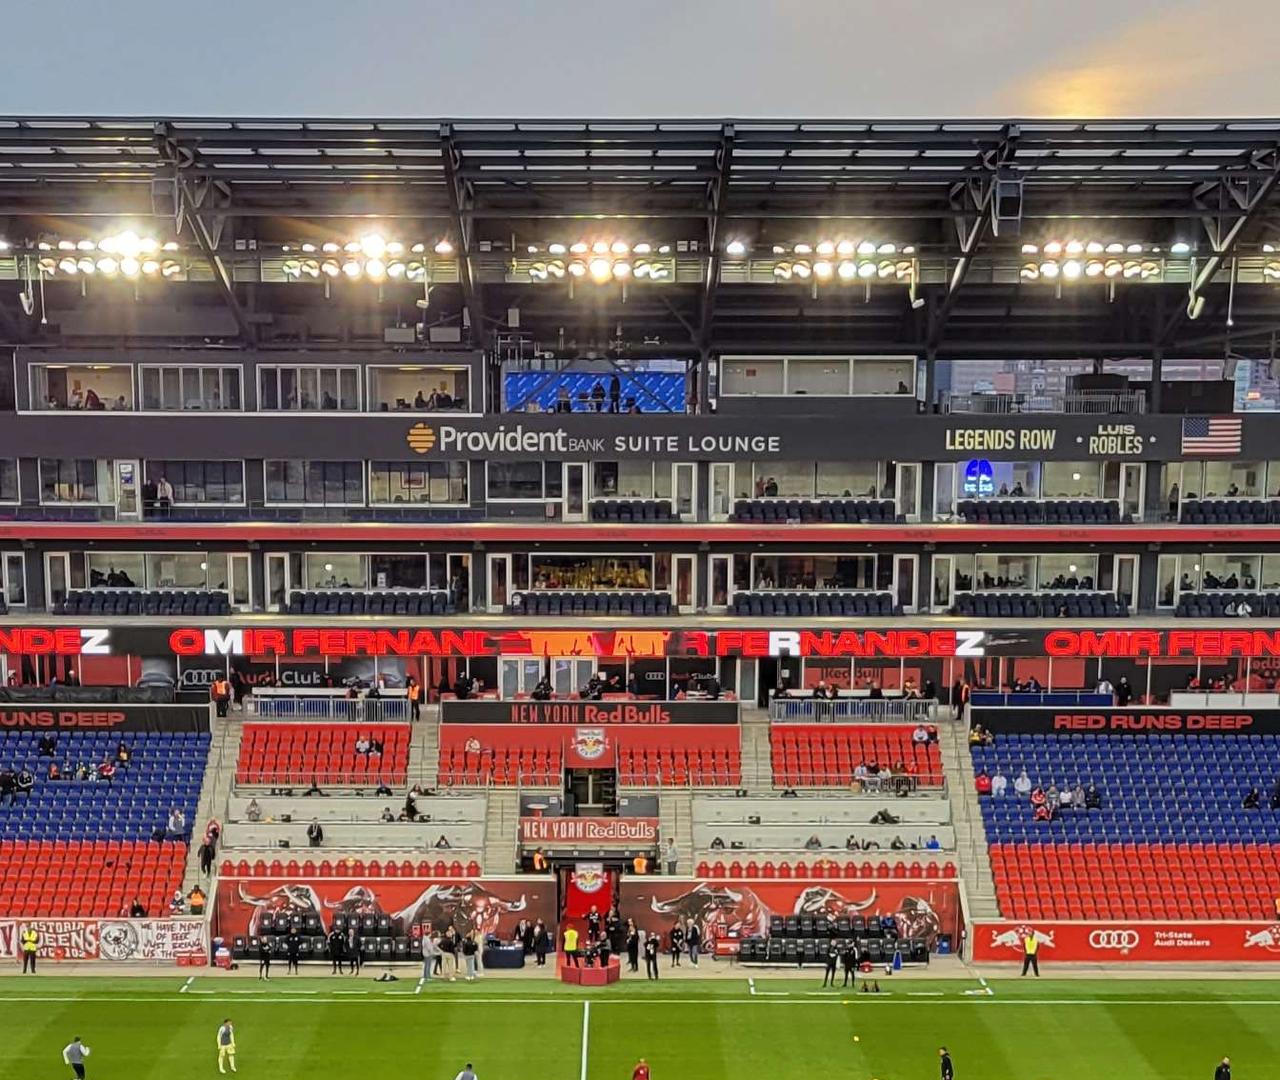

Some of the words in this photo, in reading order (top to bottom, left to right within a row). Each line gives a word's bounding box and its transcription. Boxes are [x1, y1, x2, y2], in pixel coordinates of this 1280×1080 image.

[439, 425, 568, 452] Provident
[568, 438, 605, 452] BANK
[614, 436, 679, 452] SUITE
[688, 436, 780, 452] LOUNGE
[1098, 424, 1136, 435] LUIS
[945, 429, 1015, 449] LEGENDS
[1020, 429, 1056, 449] ROW
[1089, 436, 1143, 454] ROBLES
[168, 628, 286, 655] OMIR
[718, 630, 985, 656] FERNANDEZ
[1044, 630, 1161, 656] OMIR
[59, 711, 126, 726] DEEP
[511, 704, 538, 722] NEW
[544, 704, 579, 722] YORK
[1054, 715, 1106, 729] RED
[1110, 715, 1183, 729] RUNS
[1186, 715, 1254, 729] DEEP
[523, 821, 548, 838] NEW
[552, 822, 583, 838] YORK
[1154, 931, 1192, 939] Tri-State
[1176, 939, 1210, 947] Dealers
